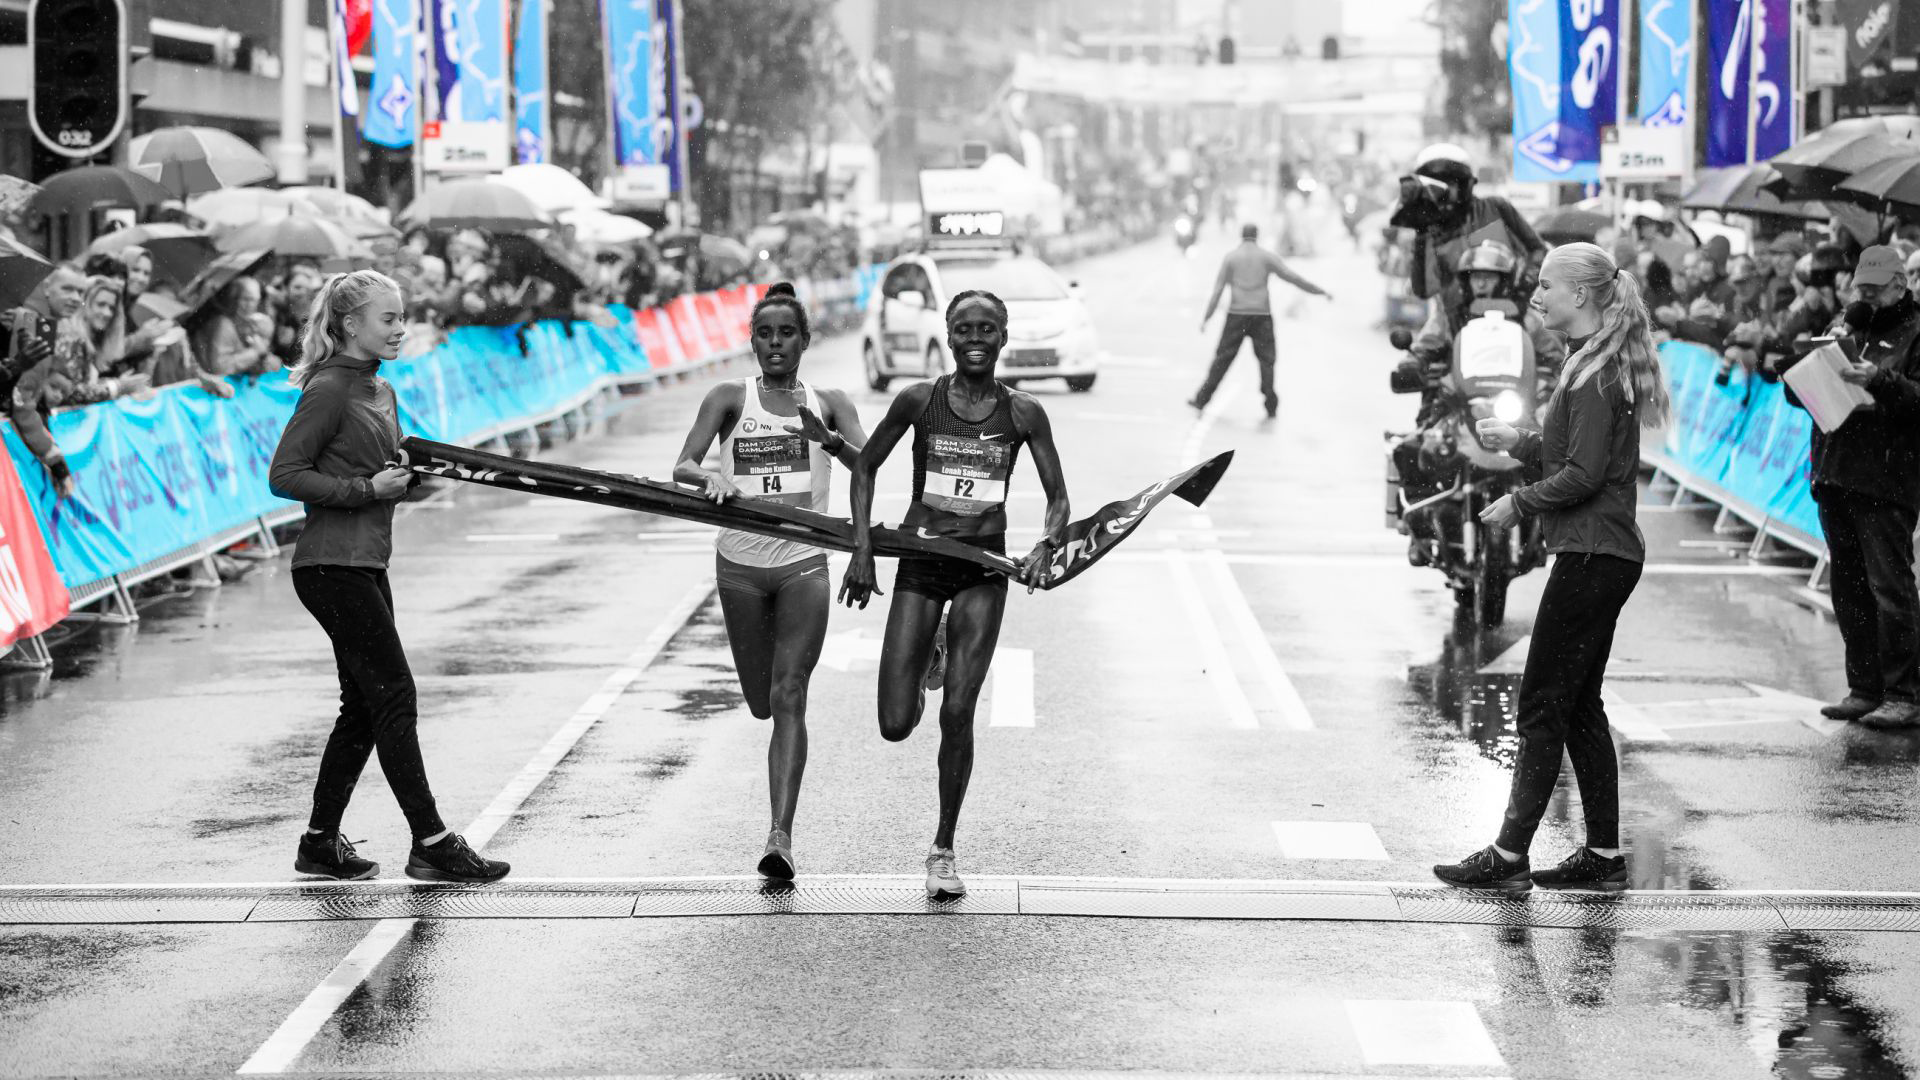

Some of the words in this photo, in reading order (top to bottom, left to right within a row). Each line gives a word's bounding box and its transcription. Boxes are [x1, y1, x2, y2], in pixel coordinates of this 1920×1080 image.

[1619, 151, 1665, 168] 25m
[935, 439, 958, 447] DAM
[738, 445, 784, 453] DAMLOOP
[935, 445, 984, 455] DAMLOOP
[773, 465, 792, 473] Kuma
[942, 466, 961, 475] Lonah
[962, 468, 991, 479] Salpeter
[762, 475, 782, 494] F4
[954, 478, 975, 498] F2
